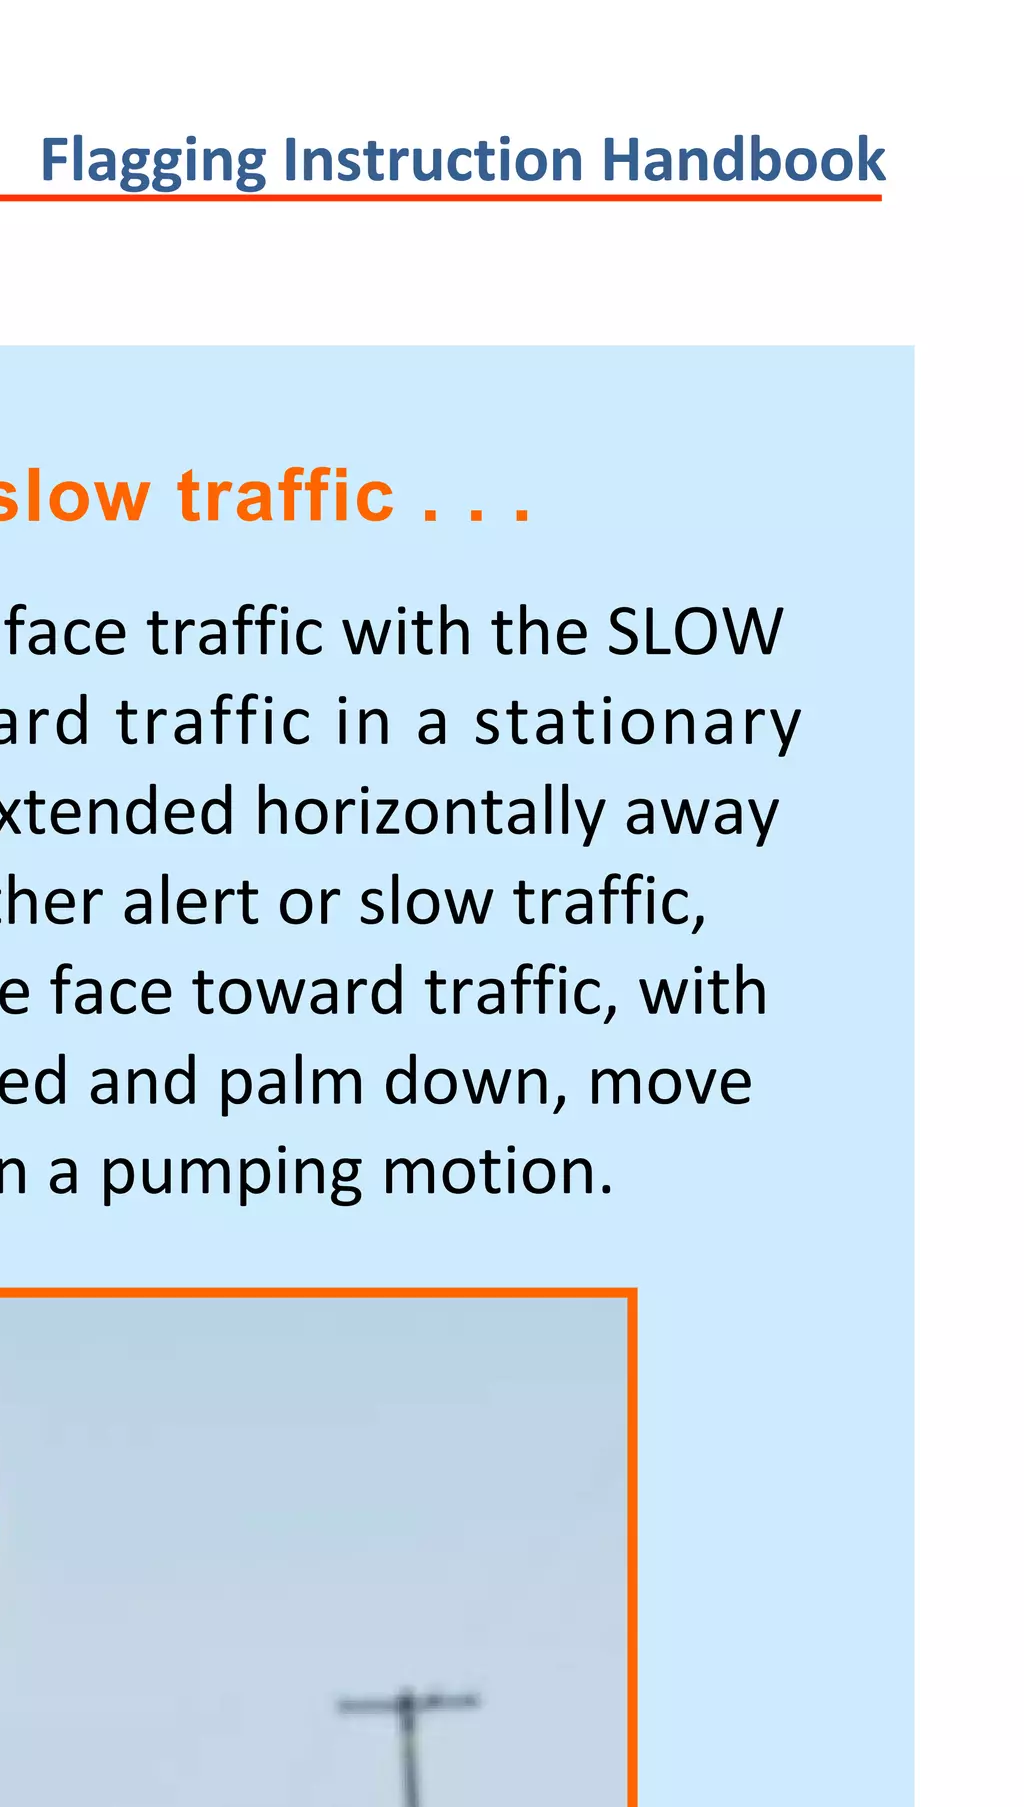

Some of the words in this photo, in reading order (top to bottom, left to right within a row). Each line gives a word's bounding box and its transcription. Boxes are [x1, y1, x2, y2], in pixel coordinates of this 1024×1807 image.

[44, 135, 266, 192] Flagging
[286, 136, 581, 181] Instruction
[605, 135, 886, 181] Handbook
[177, 467, 393, 522] traffic
[4, 604, 125, 655] face
[147, 604, 322, 655] traffic
[342, 604, 469, 655] with
[491, 604, 587, 655] the
[609, 607, 784, 655] SLOW
[116, 693, 309, 745] traffic
[339, 696, 388, 744] in
[418, 709, 445, 744] a
[476, 696, 801, 757] stationary
[259, 783, 606, 847] horizontally
[627, 799, 779, 847] away
[125, 873, 258, 924] alert
[280, 889, 340, 924] or
[361, 873, 493, 924] slow
[513, 873, 704, 934] traffic,
[50, 963, 171, 1014] face
[192, 964, 402, 1014] toward
[425, 963, 616, 1024] traffic,
[639, 963, 765, 1014] with
[91, 1054, 195, 1104] and
[222, 1053, 361, 1117] palm
[386, 1054, 565, 1114] down,
[592, 1068, 751, 1104] move
[50, 1158, 77, 1194] a
[104, 1145, 362, 1206] pumping
[386, 1145, 610, 1194] motion.
